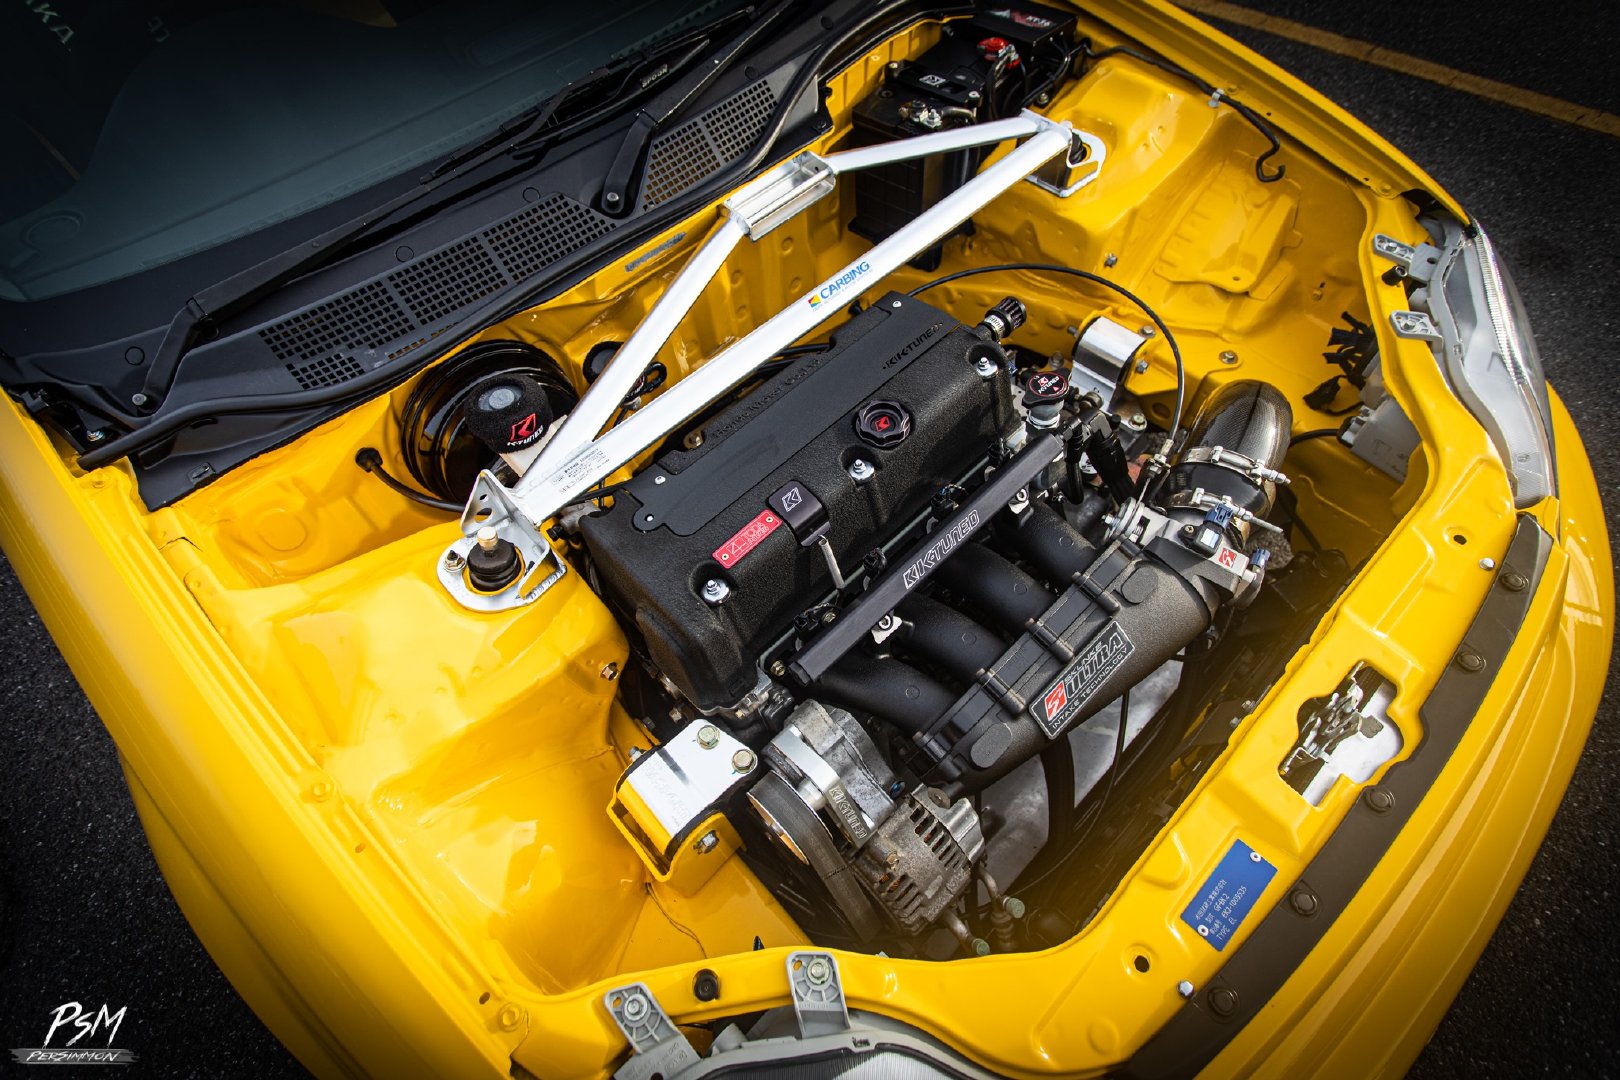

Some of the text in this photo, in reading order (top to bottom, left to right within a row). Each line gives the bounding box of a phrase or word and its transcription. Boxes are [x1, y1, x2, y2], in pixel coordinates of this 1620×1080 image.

[820, 261, 870, 299] CARBING
[1052, 647, 1128, 729] INTAKE TECHNOLOGY
[1066, 632, 1124, 699] ULTRA
[1216, 924, 1231, 941] TYPE
